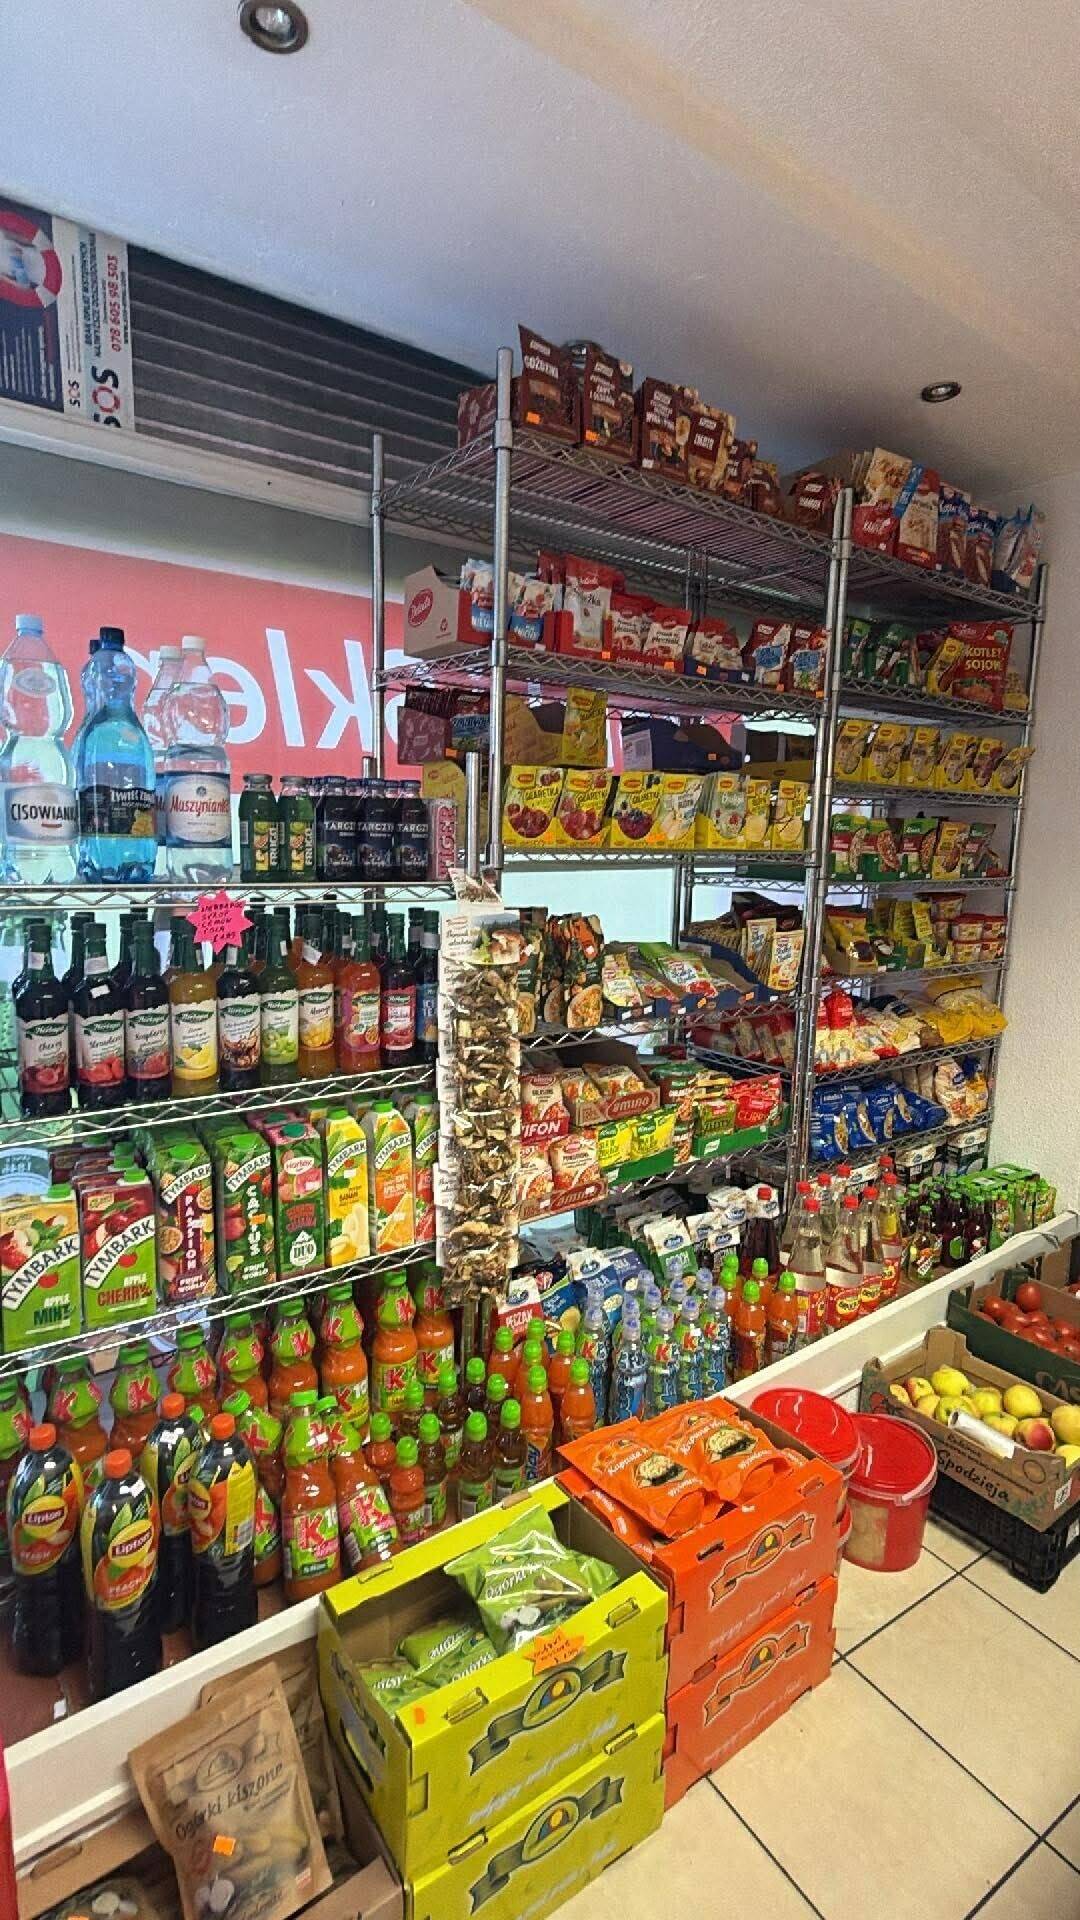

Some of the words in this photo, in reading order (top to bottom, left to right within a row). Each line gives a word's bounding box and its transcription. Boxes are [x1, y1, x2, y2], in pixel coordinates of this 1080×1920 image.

[67, 379, 81, 408] SOS
[375, 1133, 411, 1165] TYMBARK
[163, 1164, 211, 1201] TYMBARK
[227, 1152, 271, 1191] TYMBARK
[246, 1185, 262, 1257] CACTUS
[84, 1218, 154, 1283] TYMBARK
[2, 1237, 80, 1305] TYMBARK
[123, 1273, 148, 1287] APPLE
[98, 1284, 153, 1307] CHERRY
[26, 1509, 64, 1525] Lipton
[115, 1529, 152, 1555] Lipton
[174, 1799, 222, 1841] Ogórki
[227, 1762, 285, 1811] kiszone
